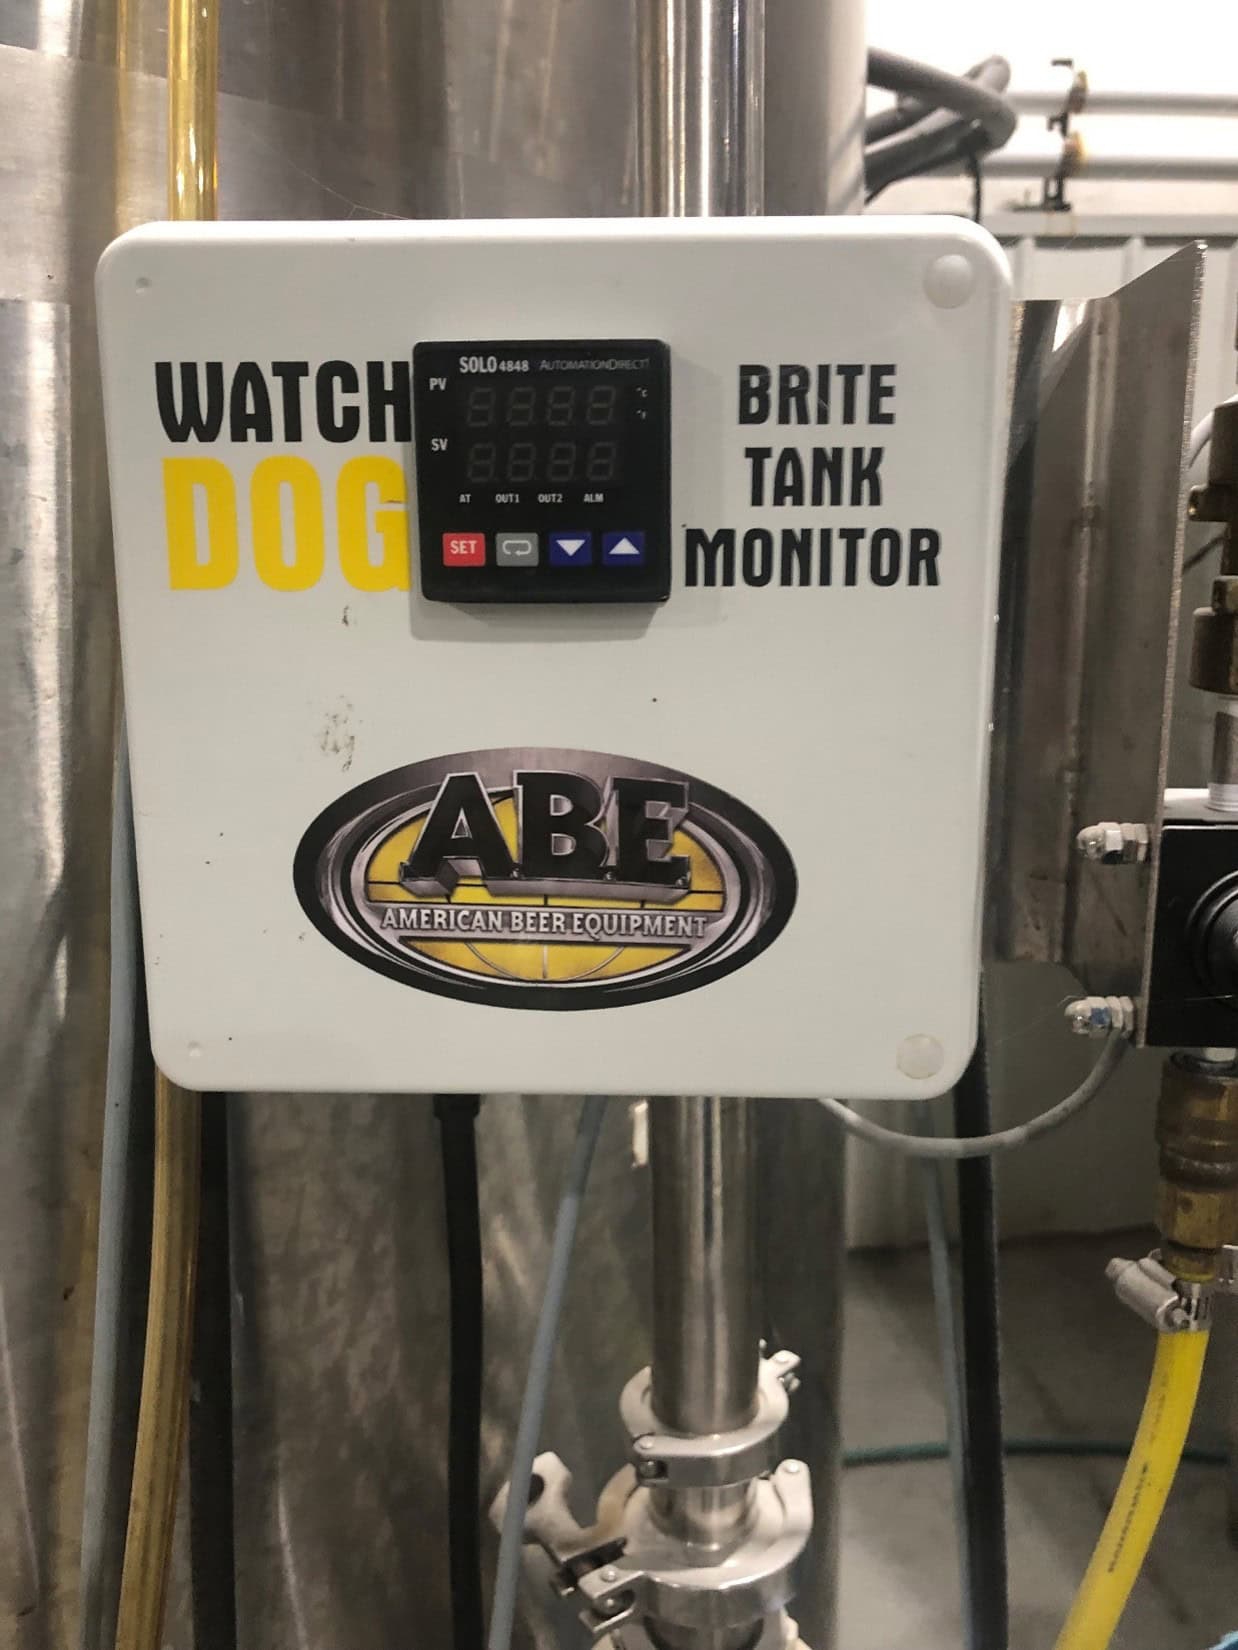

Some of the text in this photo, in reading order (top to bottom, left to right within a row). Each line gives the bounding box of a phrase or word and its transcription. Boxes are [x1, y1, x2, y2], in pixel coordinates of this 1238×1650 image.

[458, 356, 497, 373] SOLO
[499, 360, 530, 372] 4848
[429, 378, 447, 391] PV
[155, 360, 412, 443] WATCH
[738, 364, 896, 425] BRITE
[431, 438, 448, 451] SV
[744, 447, 885, 507] TANK
[459, 493, 471, 504] AT
[495, 493, 520, 504] OUT1
[538, 493, 563, 504] OUT2
[583, 493, 604, 503] ALM
[162, 455, 411, 592] DOG
[450, 540, 477, 555] SET
[684, 527, 941, 588] MONITOR
[381, 907, 708, 941] AMERICAN BEER EQUIPMENT
